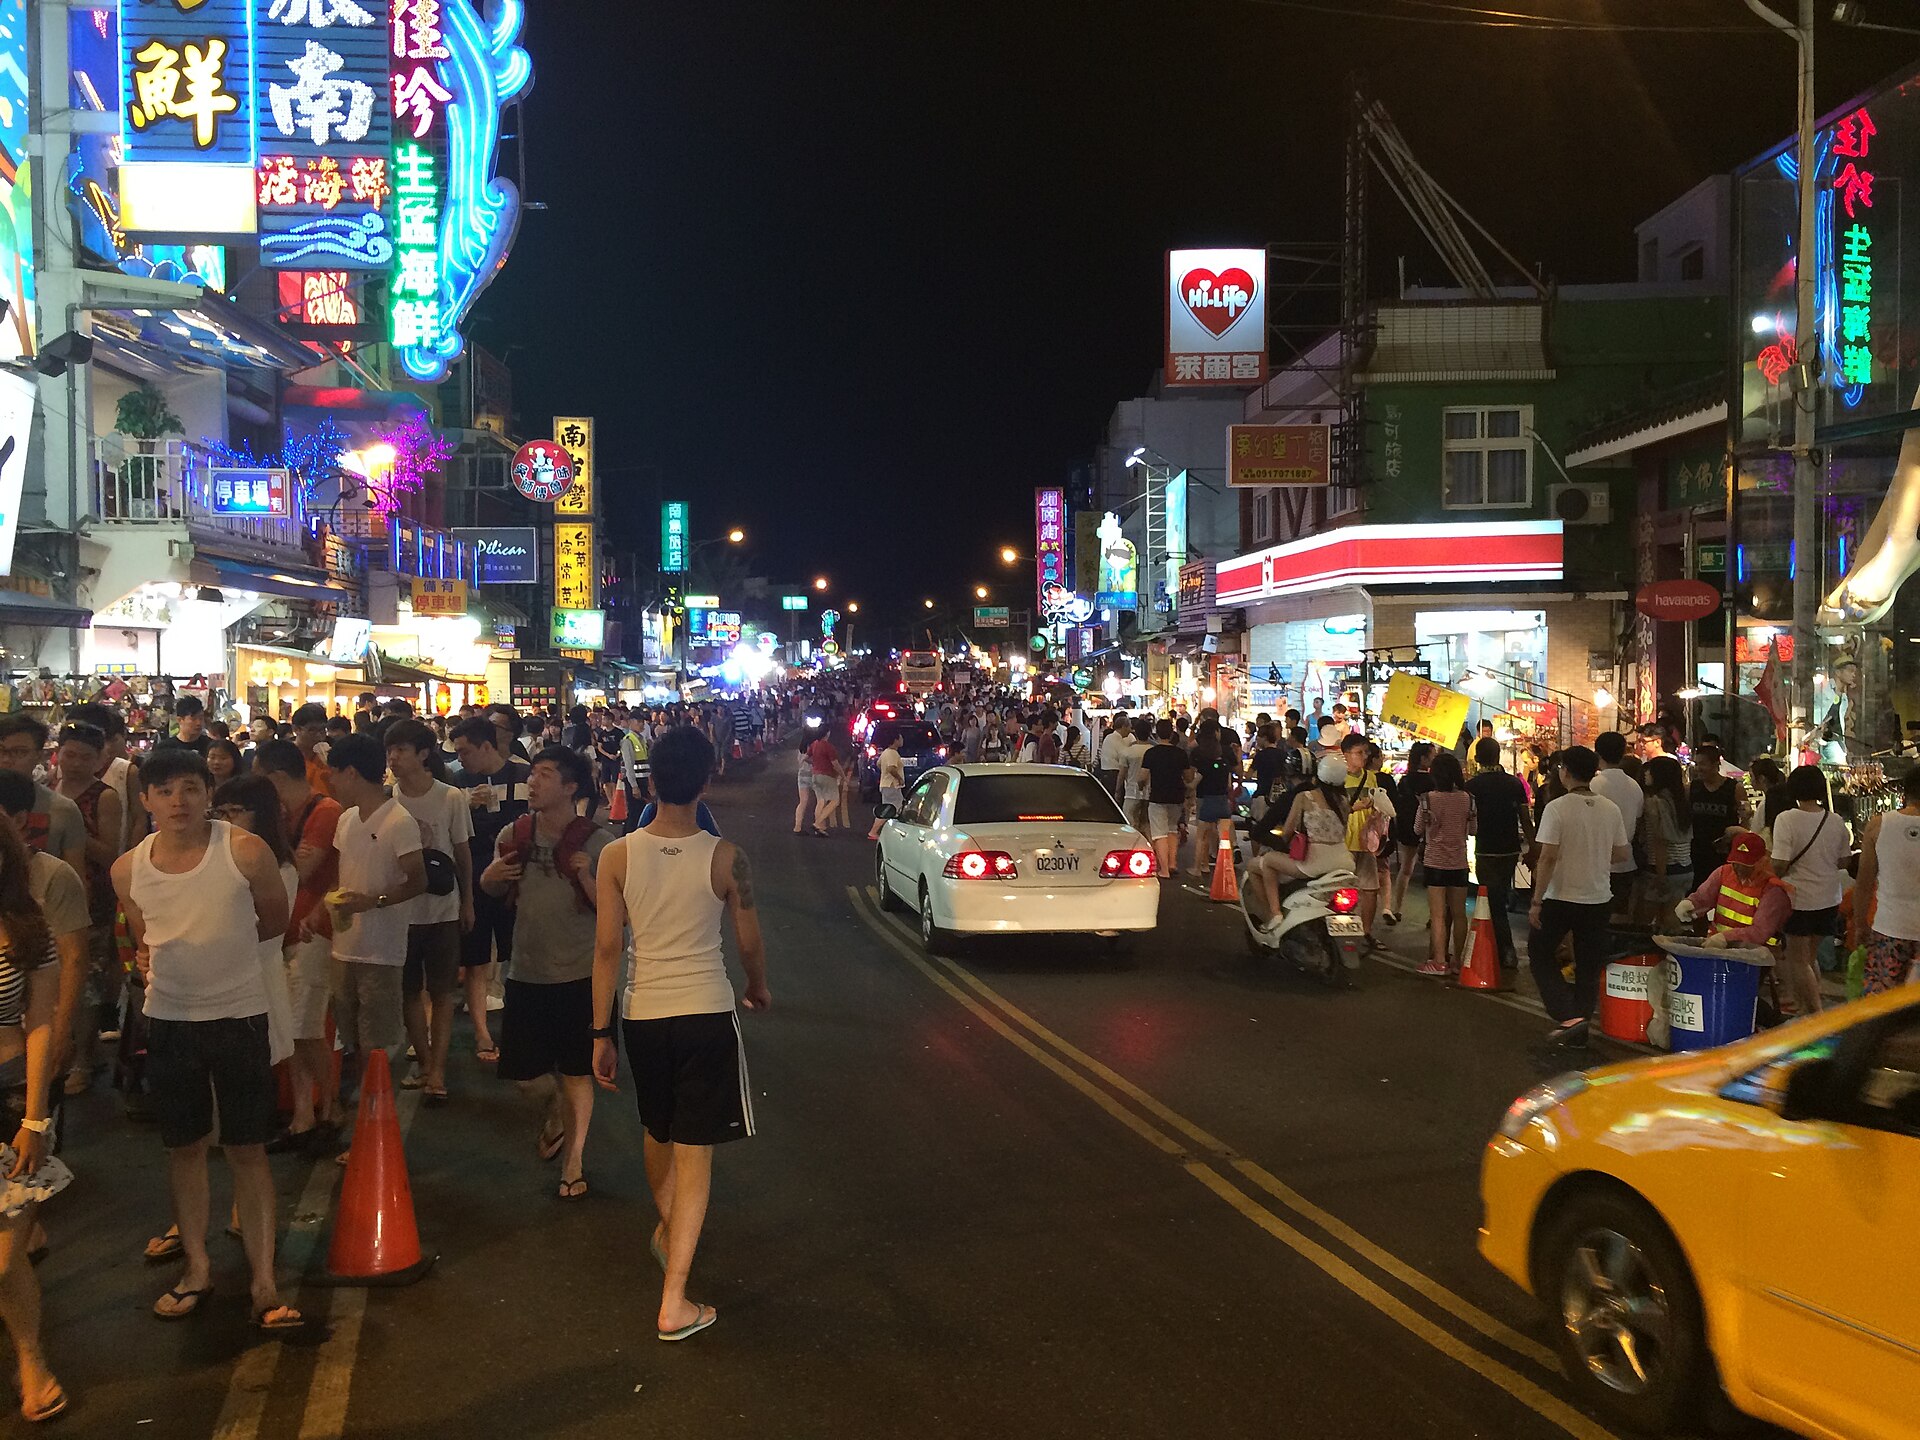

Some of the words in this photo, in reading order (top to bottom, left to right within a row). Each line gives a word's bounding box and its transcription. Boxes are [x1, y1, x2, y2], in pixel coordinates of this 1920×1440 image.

[131, 0, 238, 146] 鮮
[266, 0, 377, 146] 南
[1174, 354, 1260, 380] 萊爾富
[215, 479, 270, 508] 停車場
[423, 580, 455, 593] 備有
[415, 594, 462, 611] 停車場
